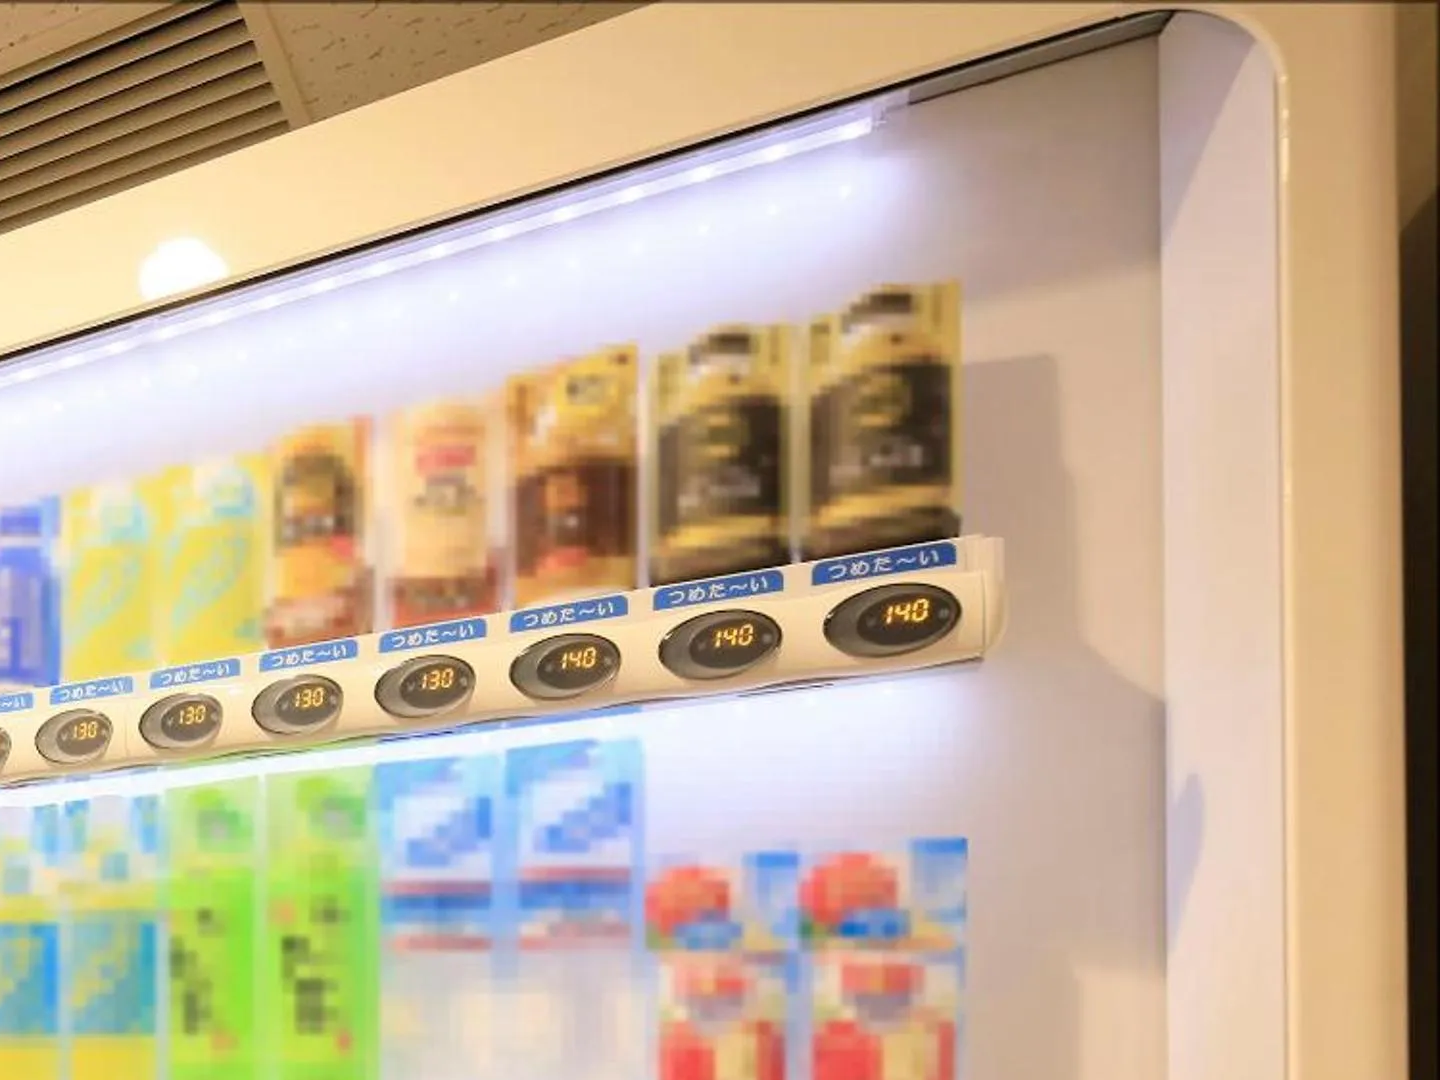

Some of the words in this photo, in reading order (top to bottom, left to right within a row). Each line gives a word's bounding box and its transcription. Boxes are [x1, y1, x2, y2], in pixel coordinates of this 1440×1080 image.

[885, 598, 930, 624] 140
[714, 622, 753, 648] 140
[560, 646, 596, 670] 140
[422, 667, 454, 690] 130
[295, 687, 325, 710] 130
[180, 704, 206, 725] 130
[74, 721, 98, 741] 130
